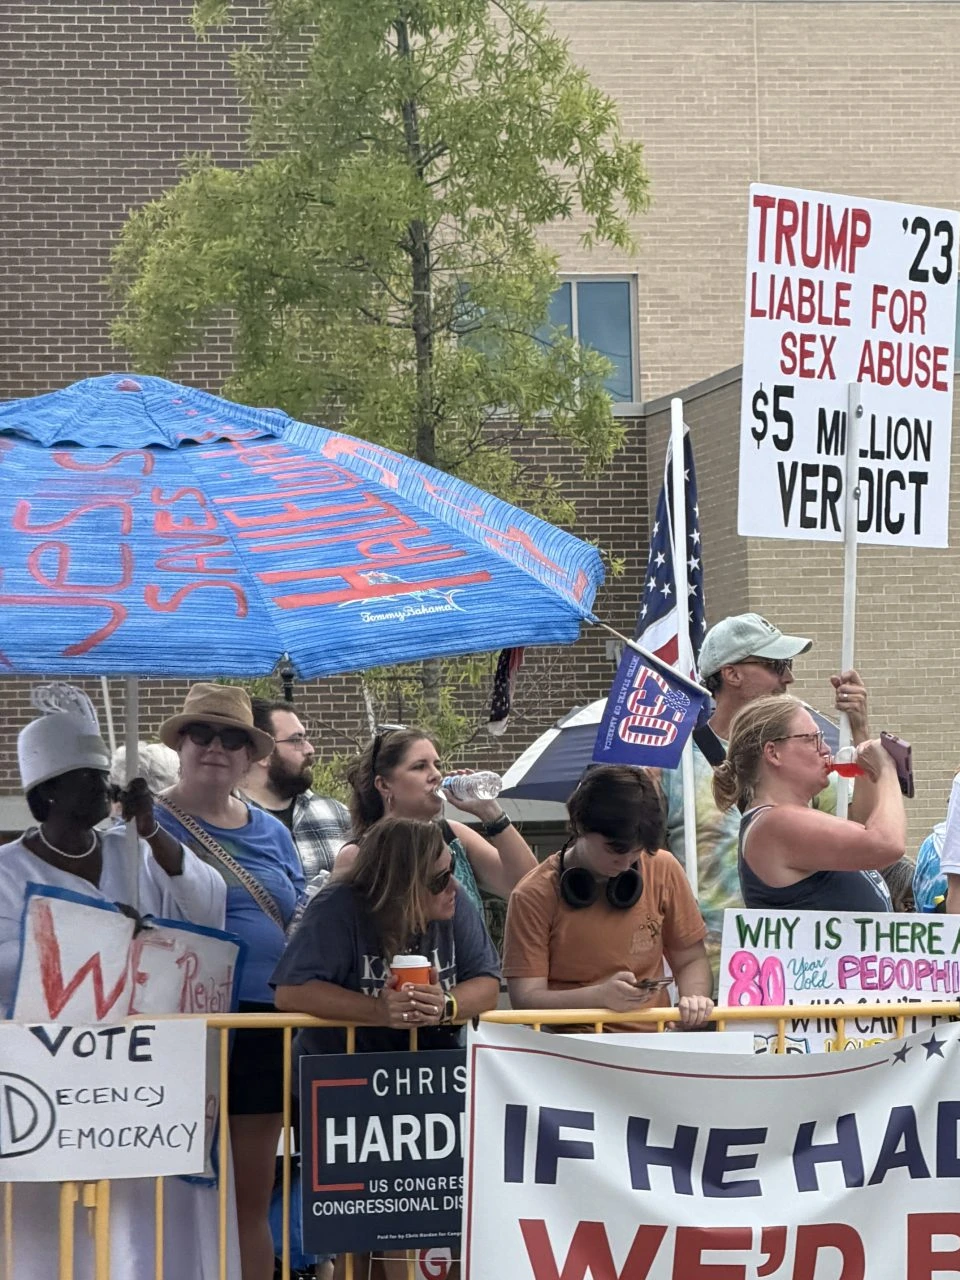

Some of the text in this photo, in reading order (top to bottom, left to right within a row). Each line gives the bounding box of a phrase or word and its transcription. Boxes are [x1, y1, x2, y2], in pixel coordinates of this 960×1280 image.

[753, 195, 871, 274] TRUMP
[750, 272, 927, 335] LIABLE FOR
[780, 331, 949, 392] SEX ABUSE
[751, 382, 932, 462] $5 MILION
[778, 461, 929, 535] VERDICT
[619, 679, 631, 704] STATES
[603, 716, 618, 751] AMERICA
[735, 914, 801, 949] WHY
[815, 917, 842, 950] IS
[854, 918, 944, 955] THERE
[728, 950, 785, 1006] 80
[29, 1025, 155, 1062] VOTE
[372, 1066, 467, 1097] CHRIS
[325, 1112, 465, 1164] HARD
[504, 1103, 595, 1184] IF
[626, 1115, 768, 1198] HE
[312, 1197, 439, 1216] CONGRESSIONAL
[369, 1180, 388, 1193] US
